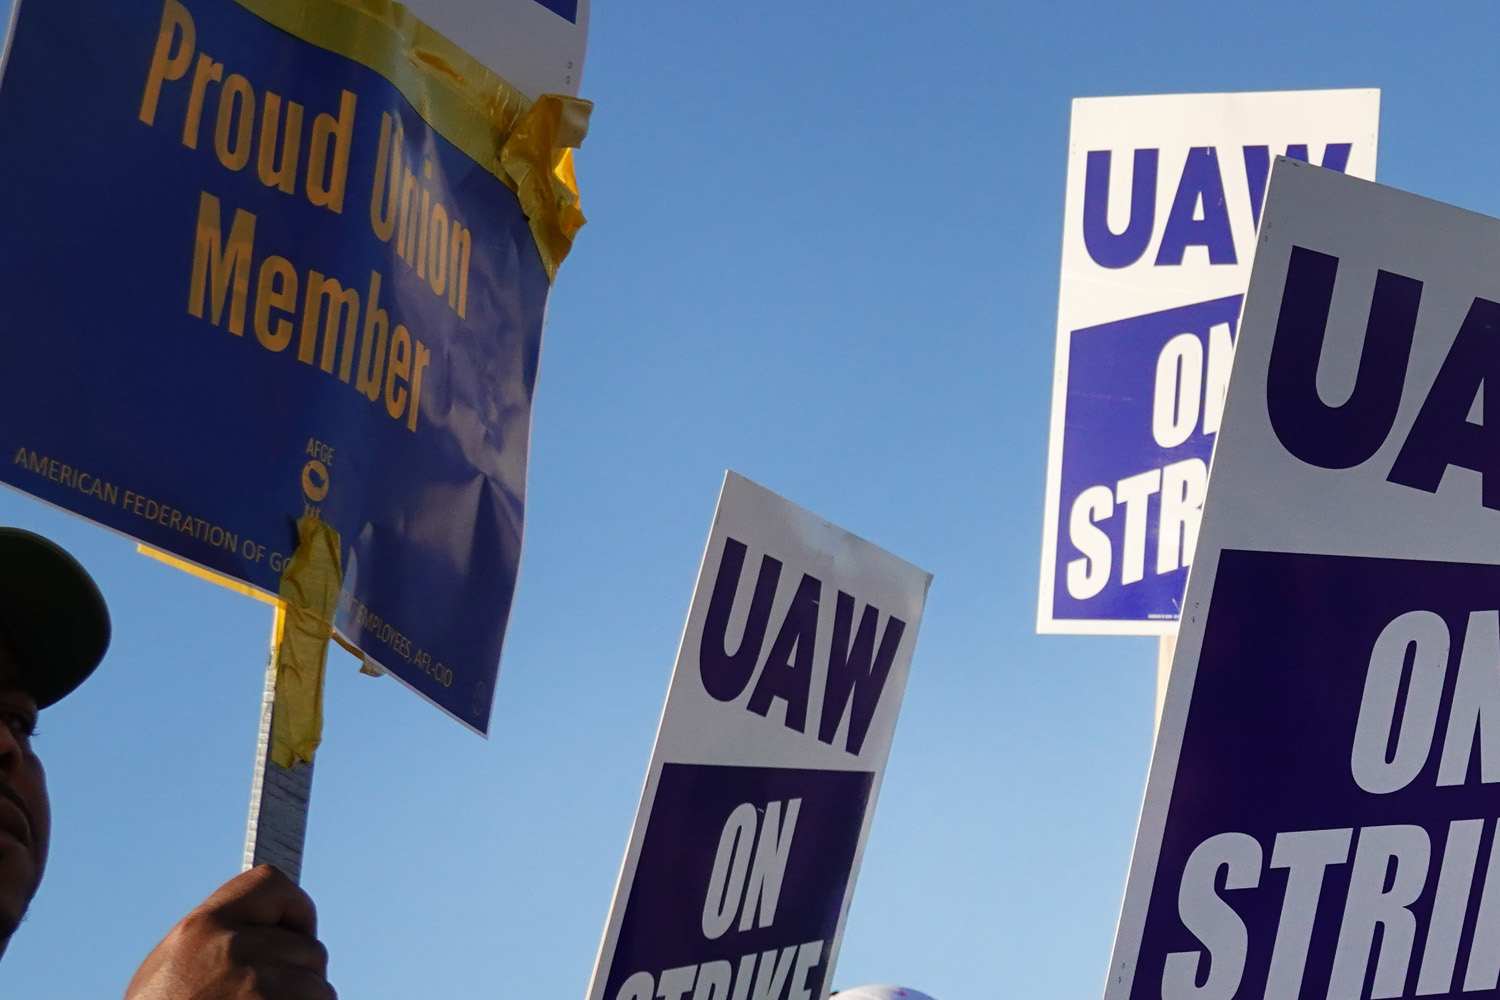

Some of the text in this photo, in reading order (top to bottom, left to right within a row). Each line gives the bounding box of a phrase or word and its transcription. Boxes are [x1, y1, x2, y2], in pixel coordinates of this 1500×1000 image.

[139, 0, 472, 320] Proud Union
[187, 190, 431, 433] Member
[14, 447, 265, 565] AMERICAN FEDERATION OF
[306, 437, 335, 466] AFGE
[413, 649, 453, 688] AFL-CIO
[699, 537, 907, 757] UAW
[701, 797, 802, 940] ON
